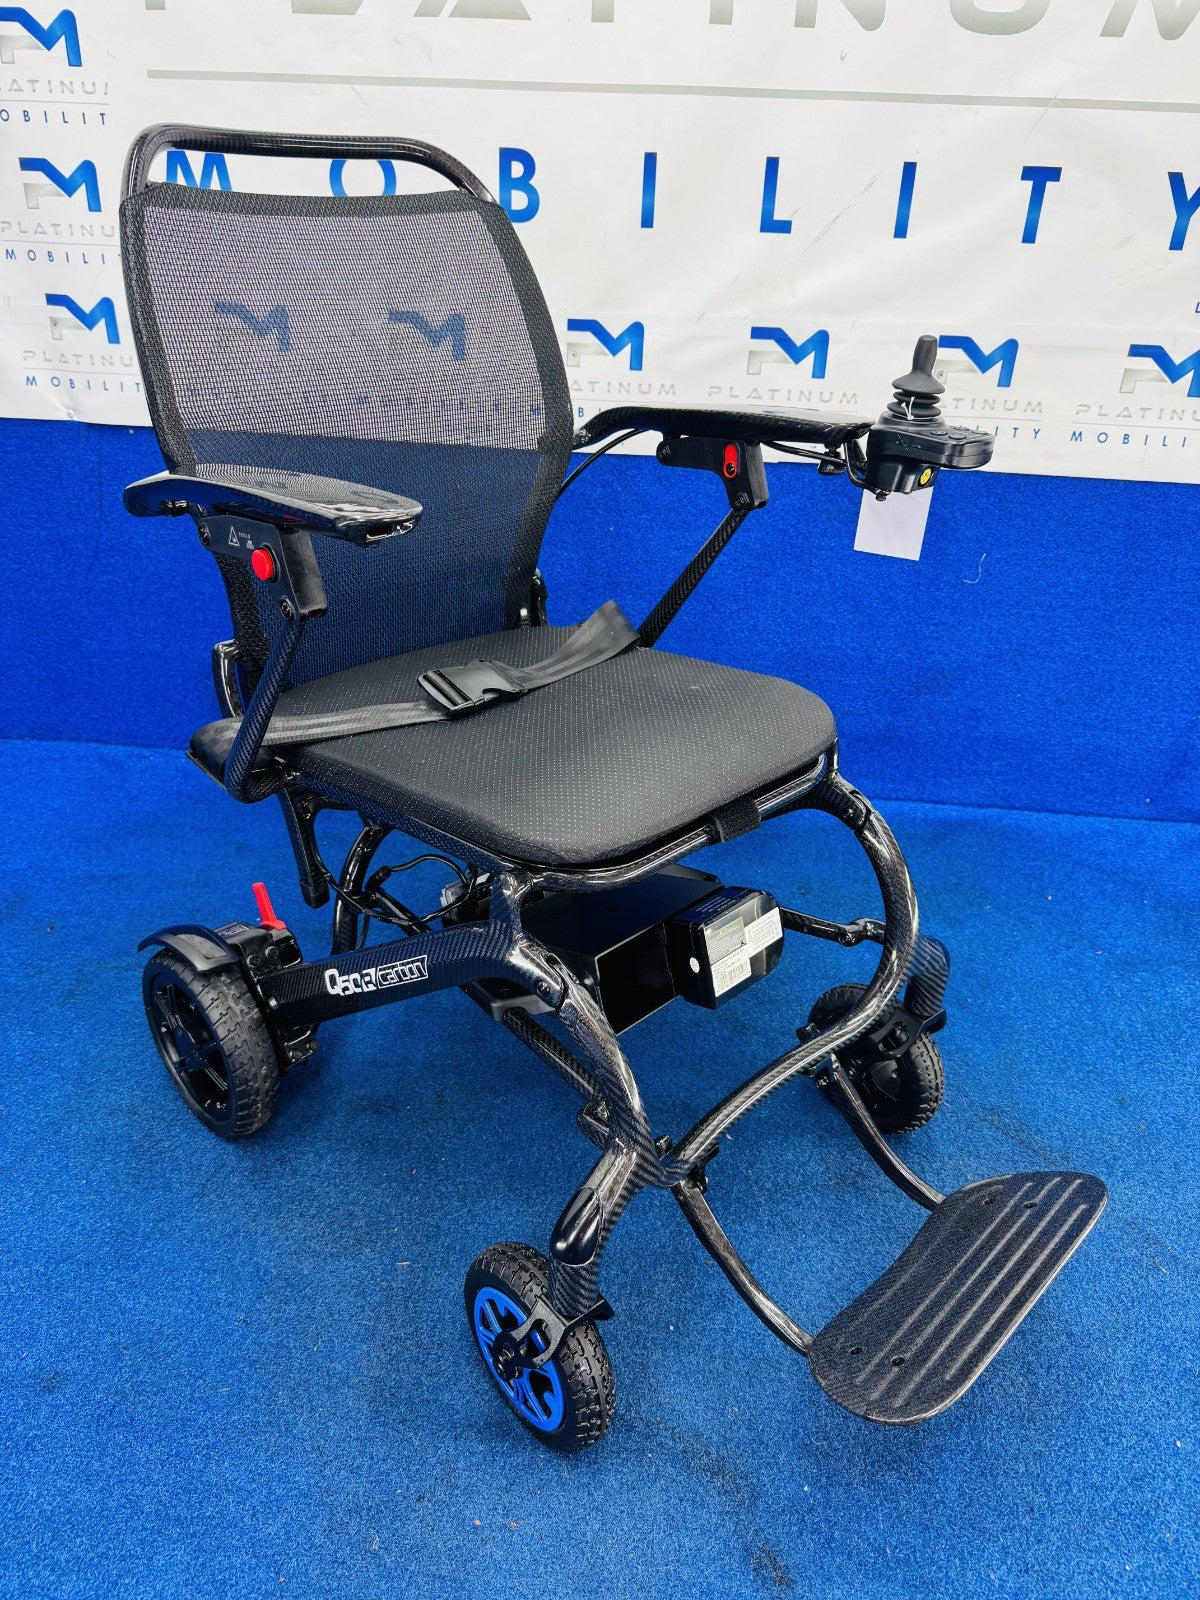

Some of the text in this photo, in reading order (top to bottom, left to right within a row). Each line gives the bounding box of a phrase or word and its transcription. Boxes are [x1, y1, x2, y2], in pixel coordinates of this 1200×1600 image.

[0, 79, 109, 95] ATINU
[6, 248, 121, 265] MOBILI
[708, 385, 858, 404] PLATINUM
[940, 397, 1043, 414] TINUM
[379, 961, 427, 986] carbon
